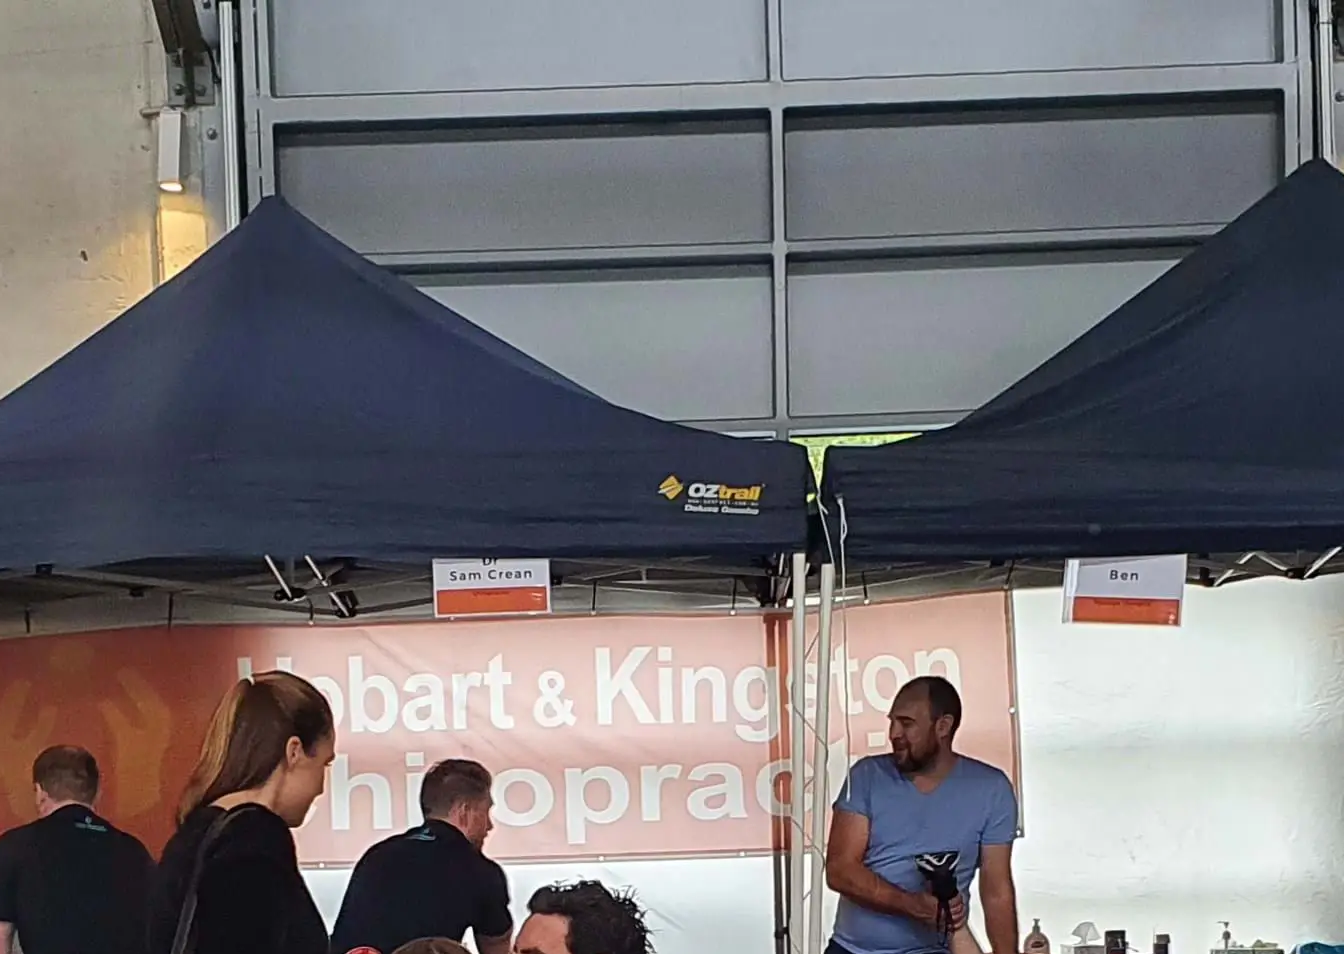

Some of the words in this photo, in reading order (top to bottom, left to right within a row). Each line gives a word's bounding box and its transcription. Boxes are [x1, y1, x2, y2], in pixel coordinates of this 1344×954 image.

[449, 571, 482, 582] Sam
[487, 569, 533, 580] Crean
[1109, 569, 1139, 581] Ben
[533, 670, 577, 728] &
